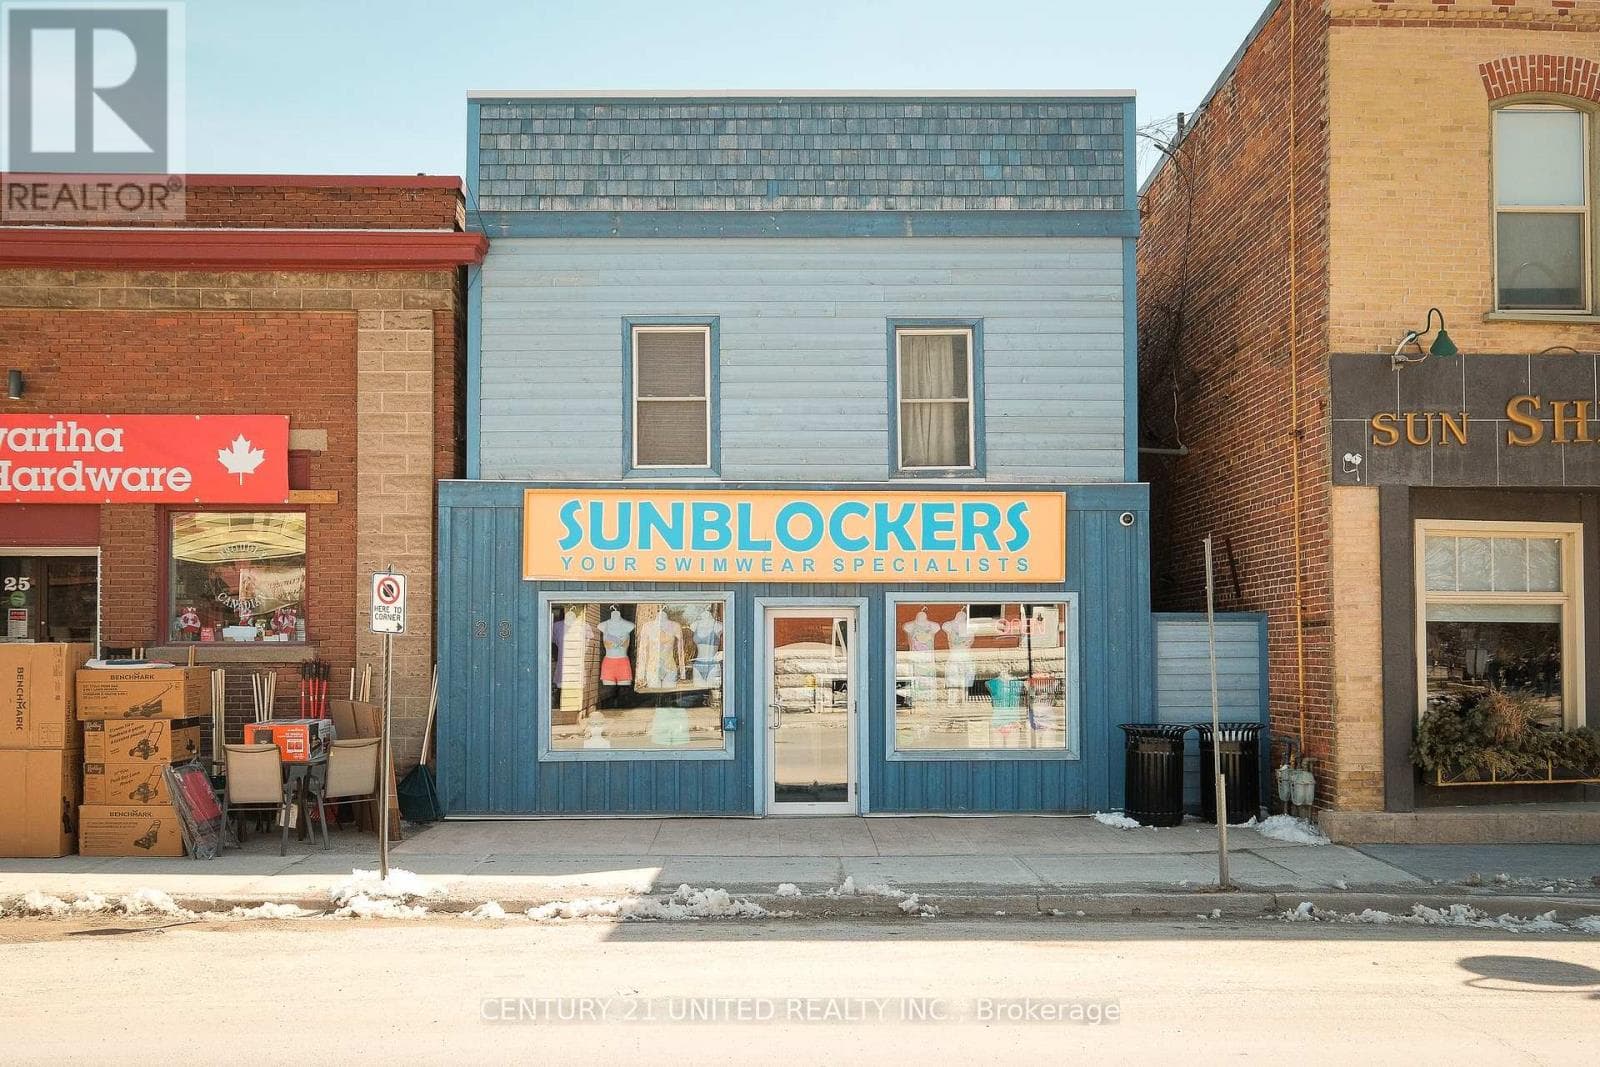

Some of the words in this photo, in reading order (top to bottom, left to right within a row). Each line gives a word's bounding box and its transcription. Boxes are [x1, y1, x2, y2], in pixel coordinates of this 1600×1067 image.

[1371, 412, 1470, 446] SUN
[1506, 394, 1600, 447] SH
[0, 421, 124, 452] artha
[558, 498, 1031, 552] SUNBLOCKERS
[561, 556, 637, 572] YOUR
[655, 557, 816, 573] SWIMWEAR
[833, 557, 1029, 573] SPECIALISTS
[4, 576, 31, 592] 25
[374, 605, 390, 614] HERE
[394, 606, 403, 614] TO
[374, 613, 401, 622] CORNER
[110, 672, 156, 681] BENCHMARK
[16, 666, 25, 731] BENCHMARK
[109, 810, 152, 818] BENCHMARK
